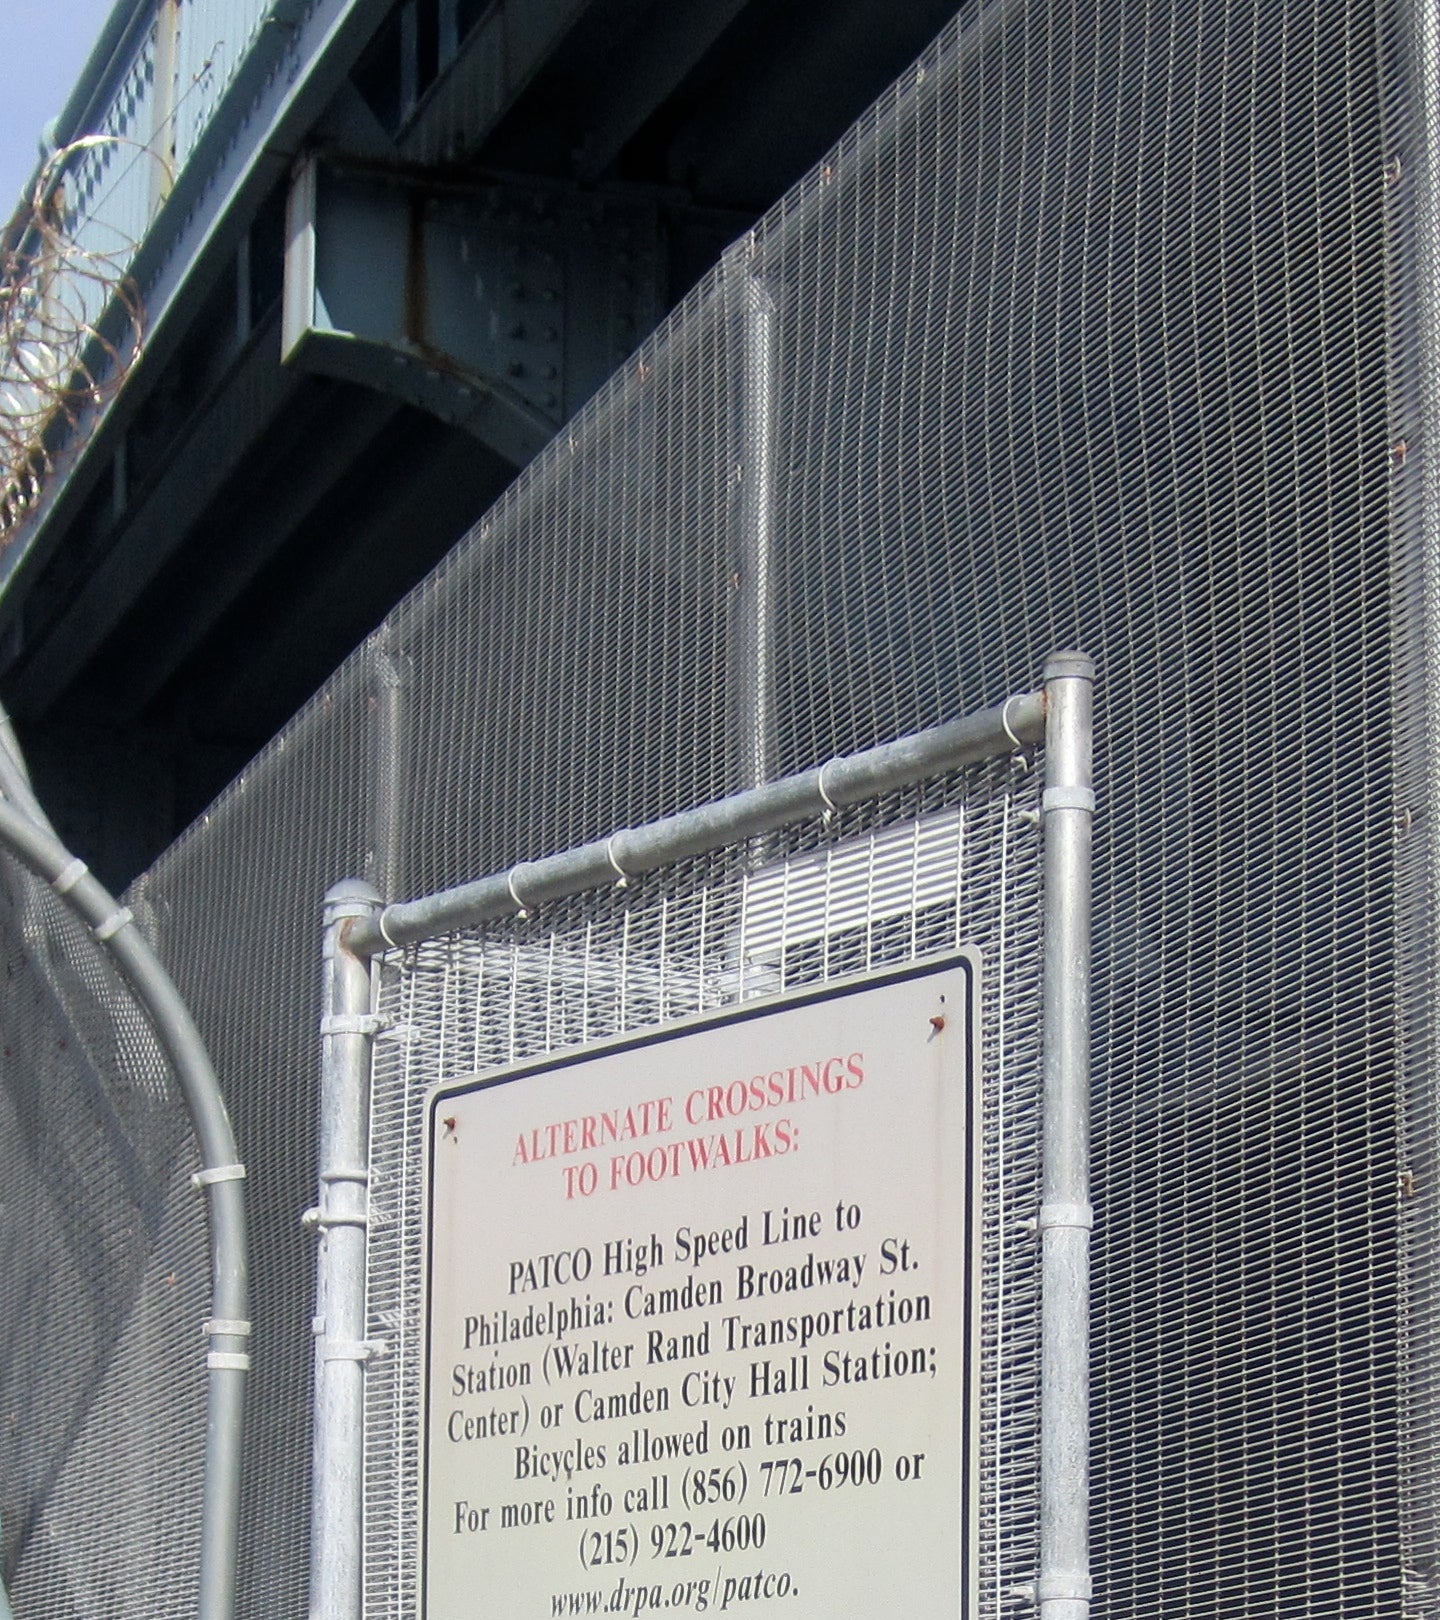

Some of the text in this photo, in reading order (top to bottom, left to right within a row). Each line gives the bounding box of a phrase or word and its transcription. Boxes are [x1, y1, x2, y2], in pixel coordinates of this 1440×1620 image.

[512, 1053, 863, 1166] ALTERNATE CROSSINGS
[563, 1118, 800, 1200] TO FOOTWALKS:
[464, 1239, 918, 1349] Philadelphia: Camden Broadway St.
[510, 1202, 860, 1294] PATCO High Speed Line to
[452, 1290, 930, 1397] Station (Walter Rand Transportation
[448, 1342, 936, 1442] Center) or Camden City Hall Station;
[515, 1405, 845, 1482] Bicycles allowed on trains
[455, 1448, 924, 1533] For more info call (856) 772-6900 or
[580, 1513, 765, 1570] (215) 922-4600
